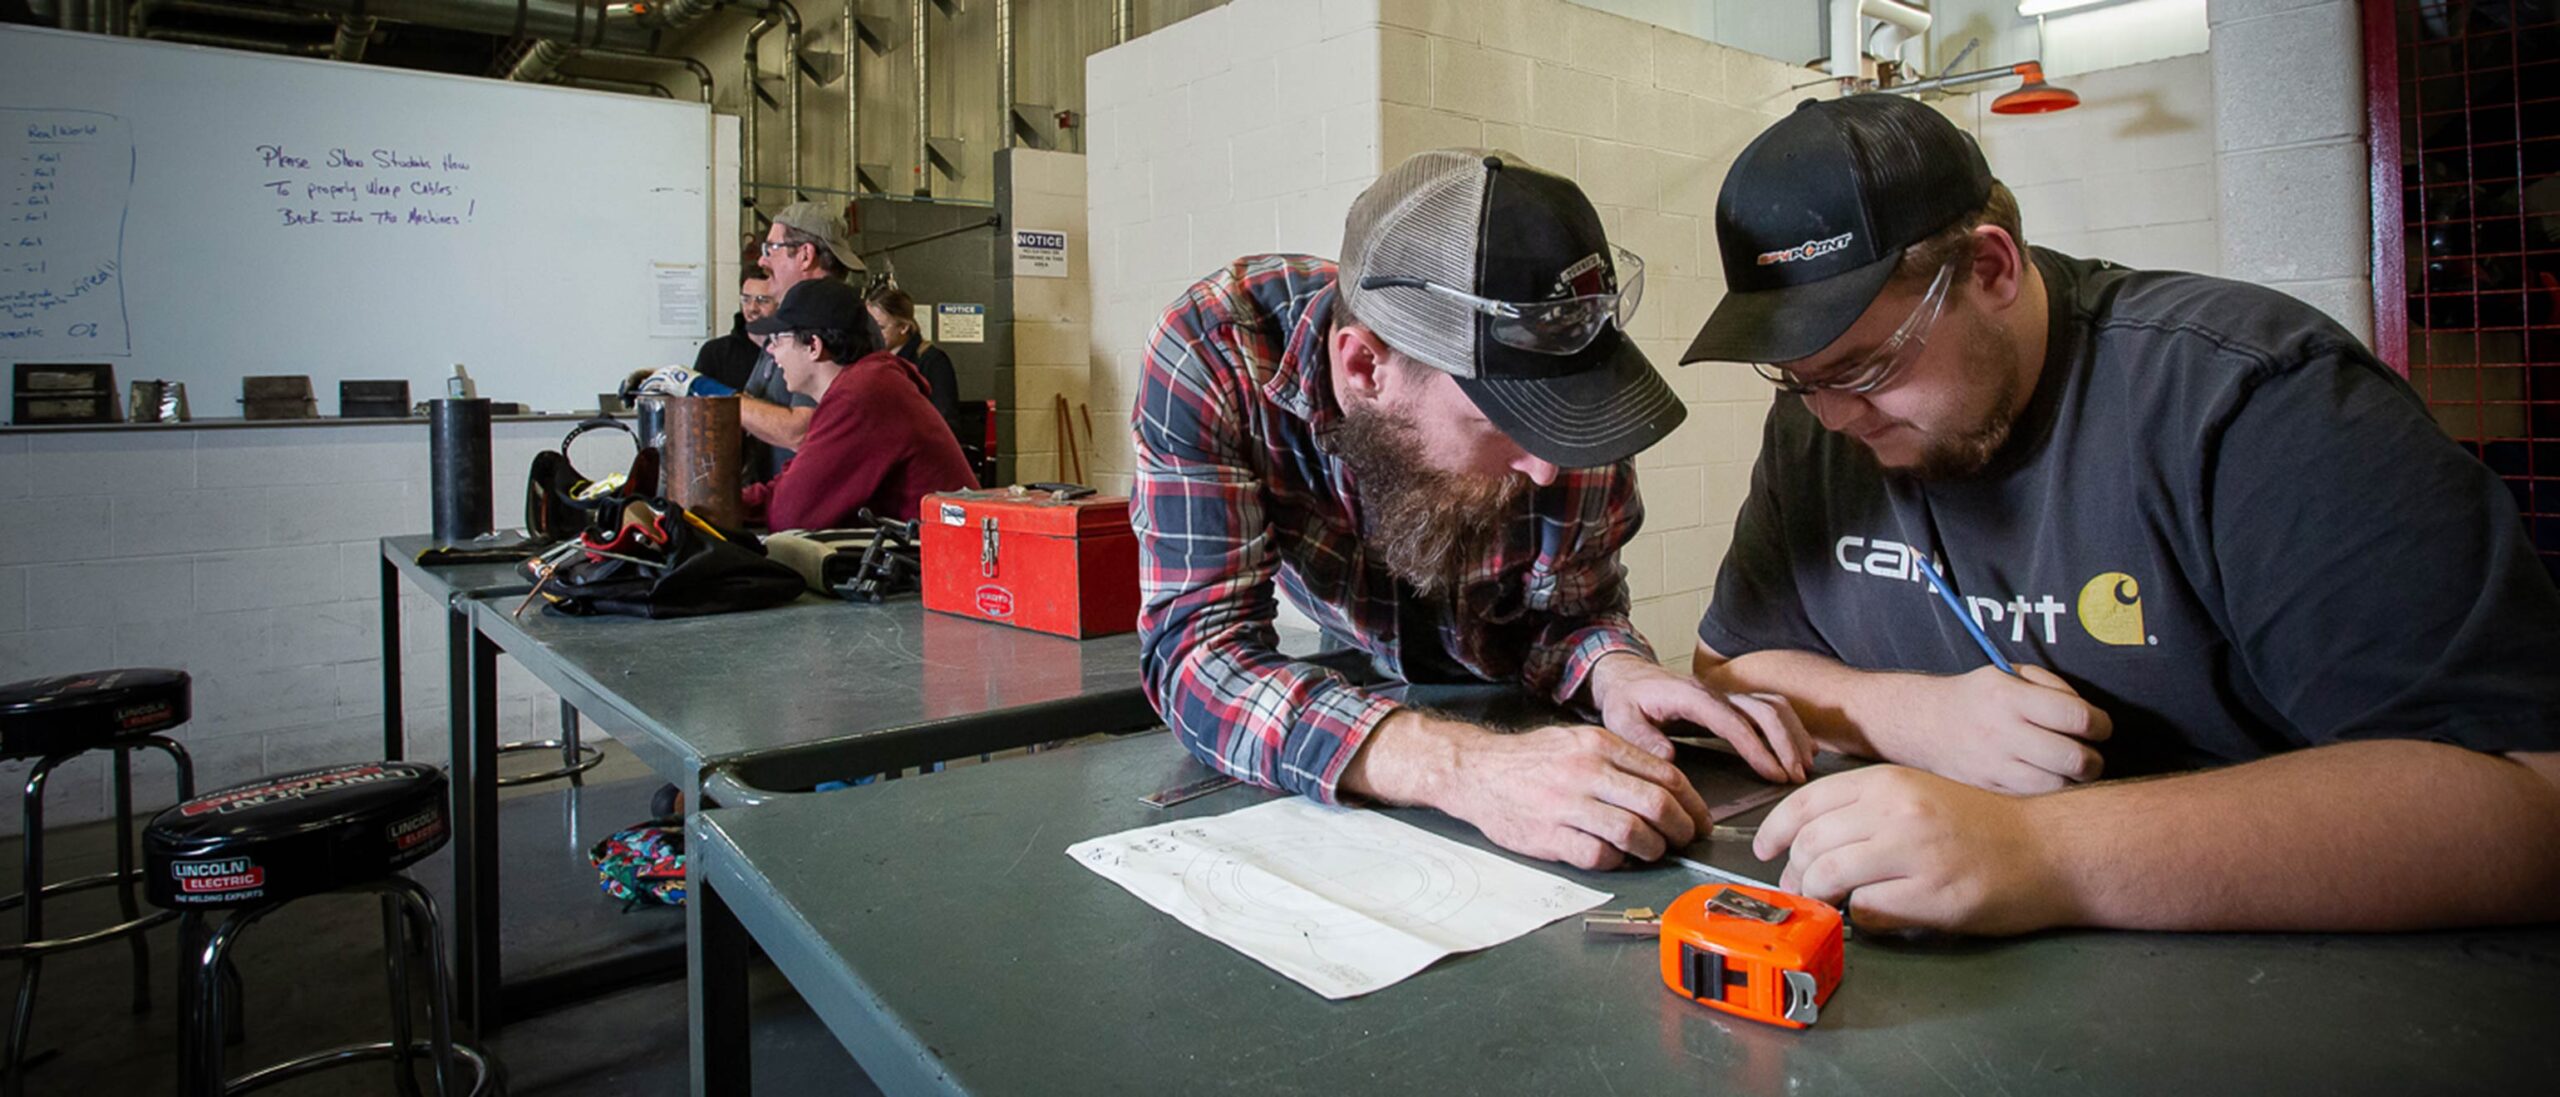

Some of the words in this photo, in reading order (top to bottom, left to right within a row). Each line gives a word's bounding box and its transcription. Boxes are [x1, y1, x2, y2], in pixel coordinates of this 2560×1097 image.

[264, 181, 291, 196] To
[307, 181, 357, 201] properly
[1018, 234, 1063, 247] NOTICE
[1757, 232, 1853, 265] SPYPOINT
[175, 861, 245, 877] LINCOLN
[191, 874, 255, 889] ELECTRIC
[175, 893, 187, 902] THE
[188, 893, 223, 902] WELDING
[224, 889, 264, 901] EXPERTS
